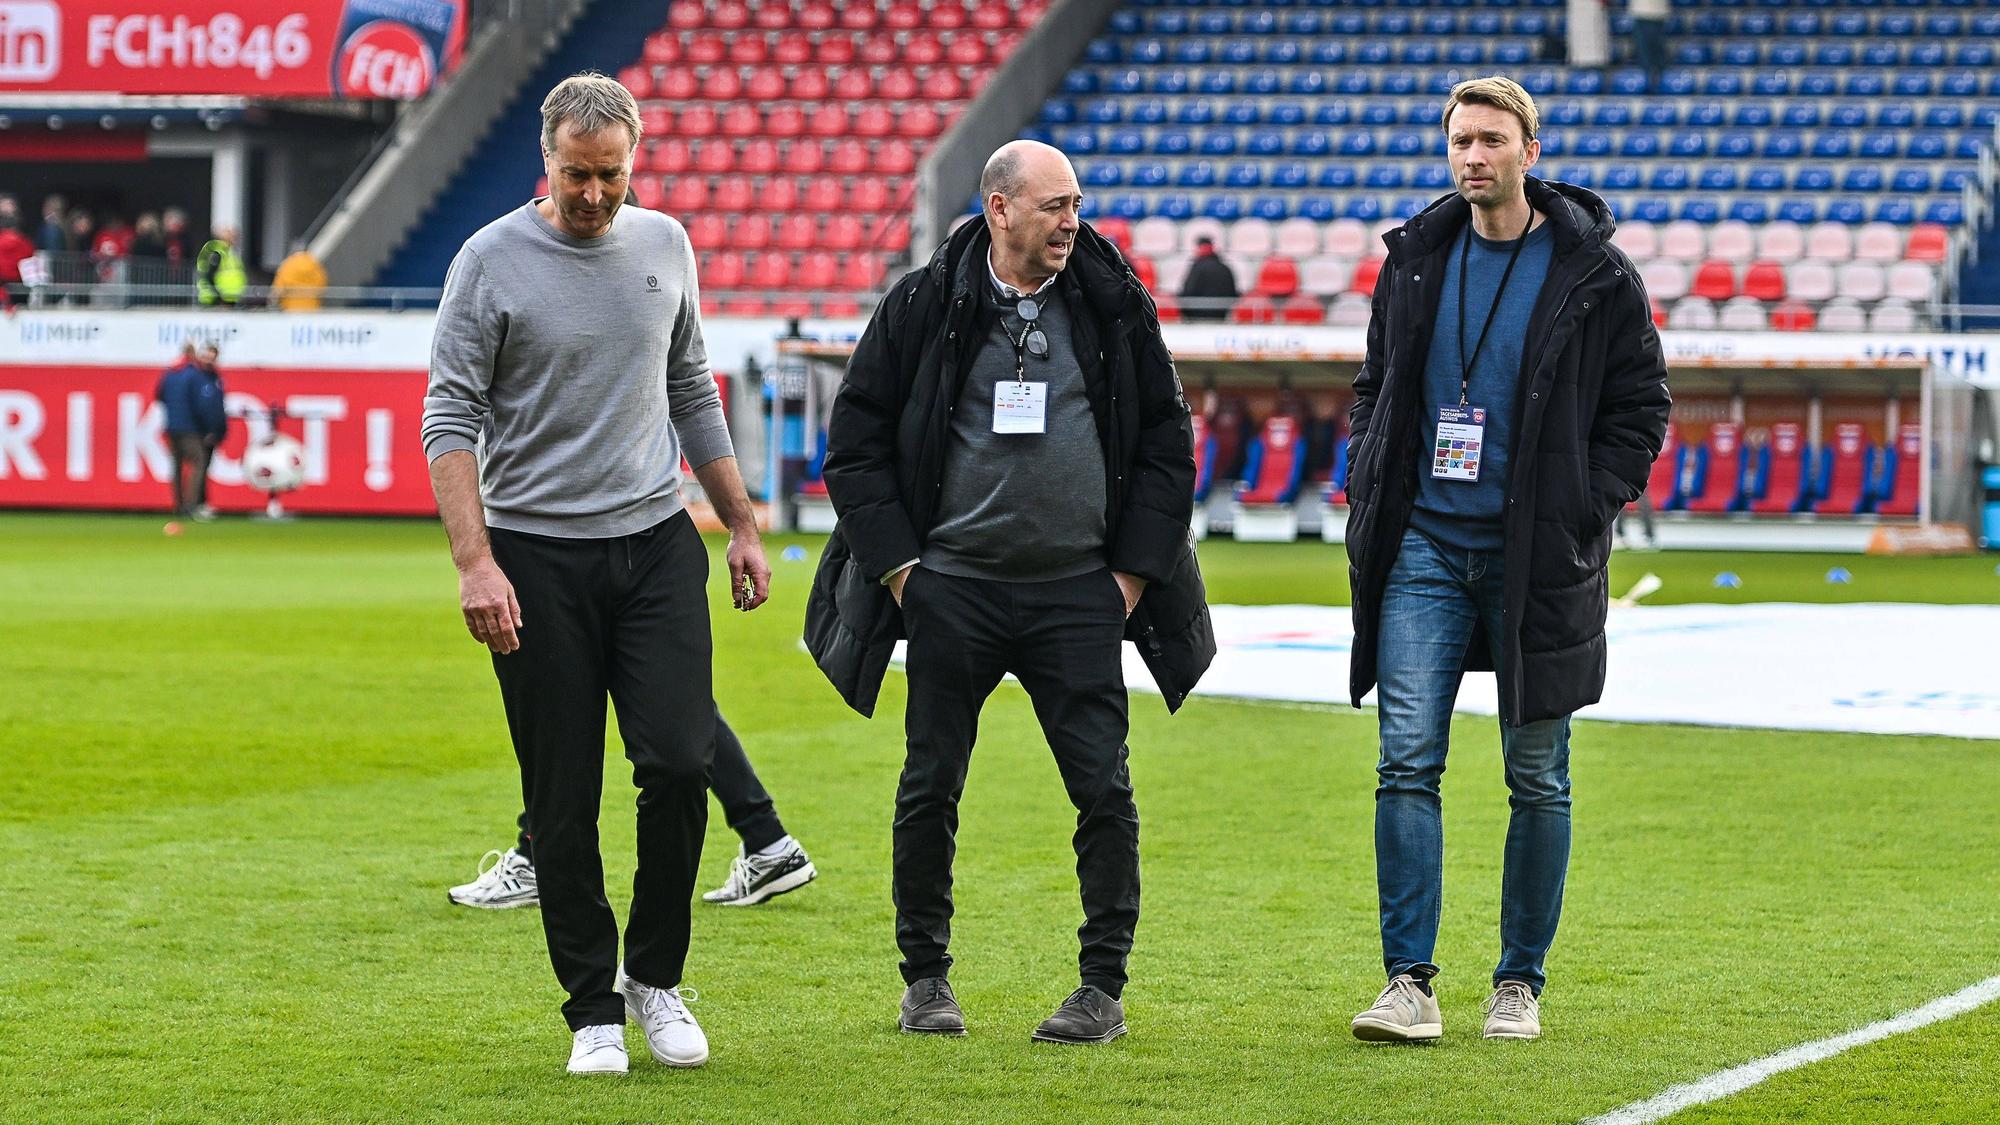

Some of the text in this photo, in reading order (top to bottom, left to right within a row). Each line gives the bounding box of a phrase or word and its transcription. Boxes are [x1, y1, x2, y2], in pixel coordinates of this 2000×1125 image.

[0, 15, 46, 64] in
[87, 12, 312, 80] FCH1846
[348, 43, 422, 99] FCH
